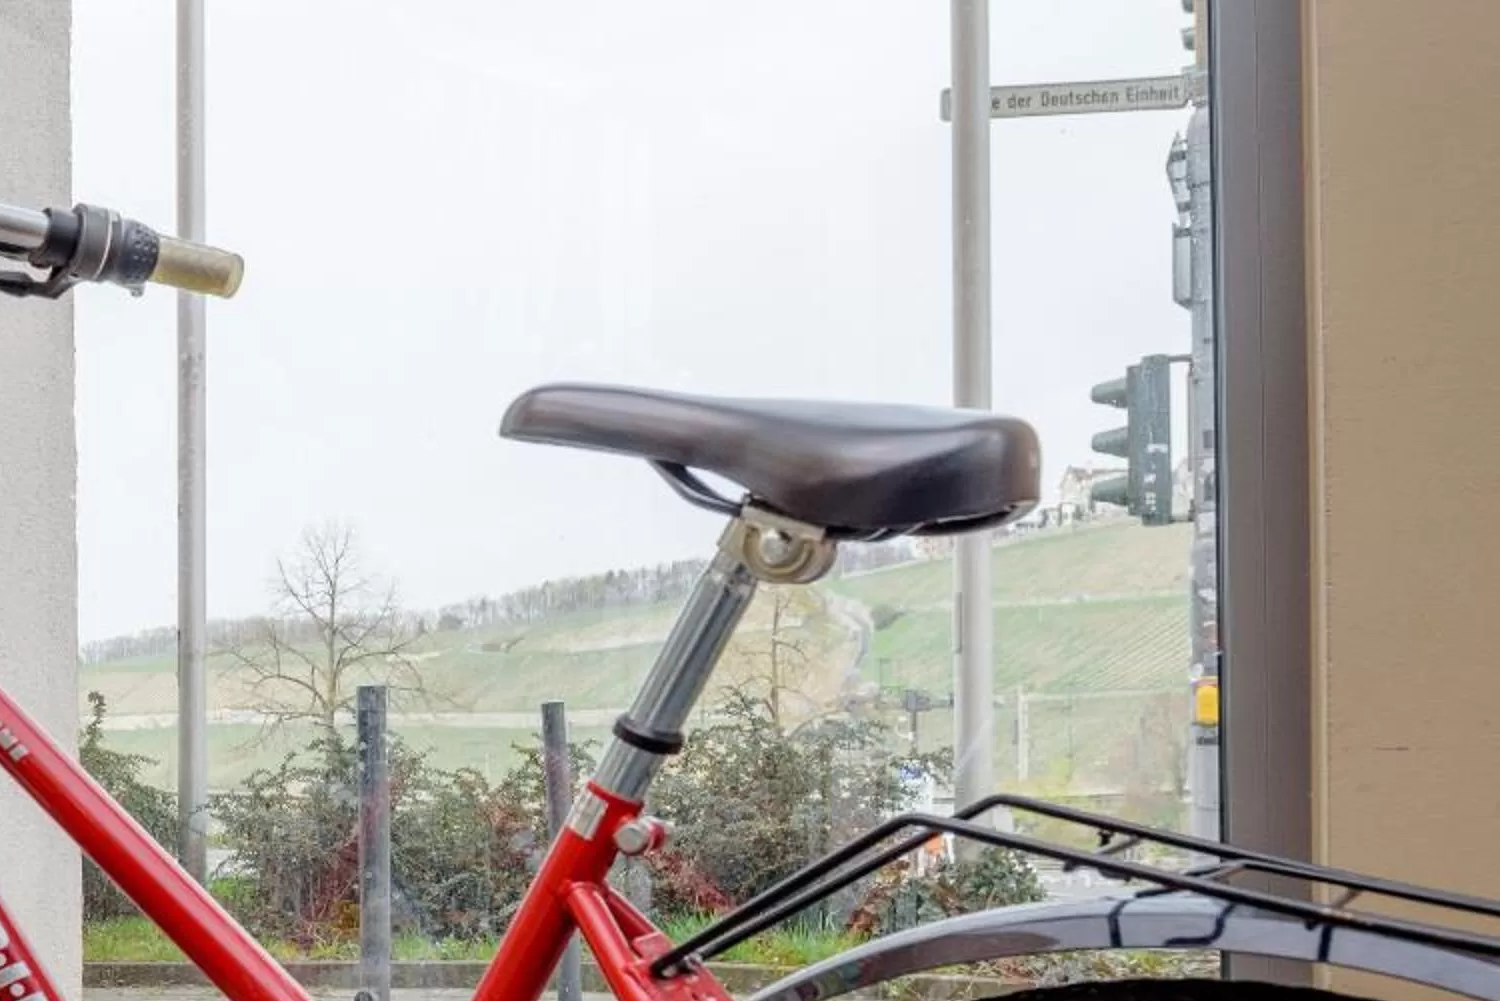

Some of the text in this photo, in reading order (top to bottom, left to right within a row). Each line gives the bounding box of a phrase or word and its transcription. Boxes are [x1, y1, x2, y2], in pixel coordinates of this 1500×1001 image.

[1008, 94, 1032, 109] der
[1041, 89, 1119, 107] Deutschen
[1126, 86, 1179, 103] Einheit
